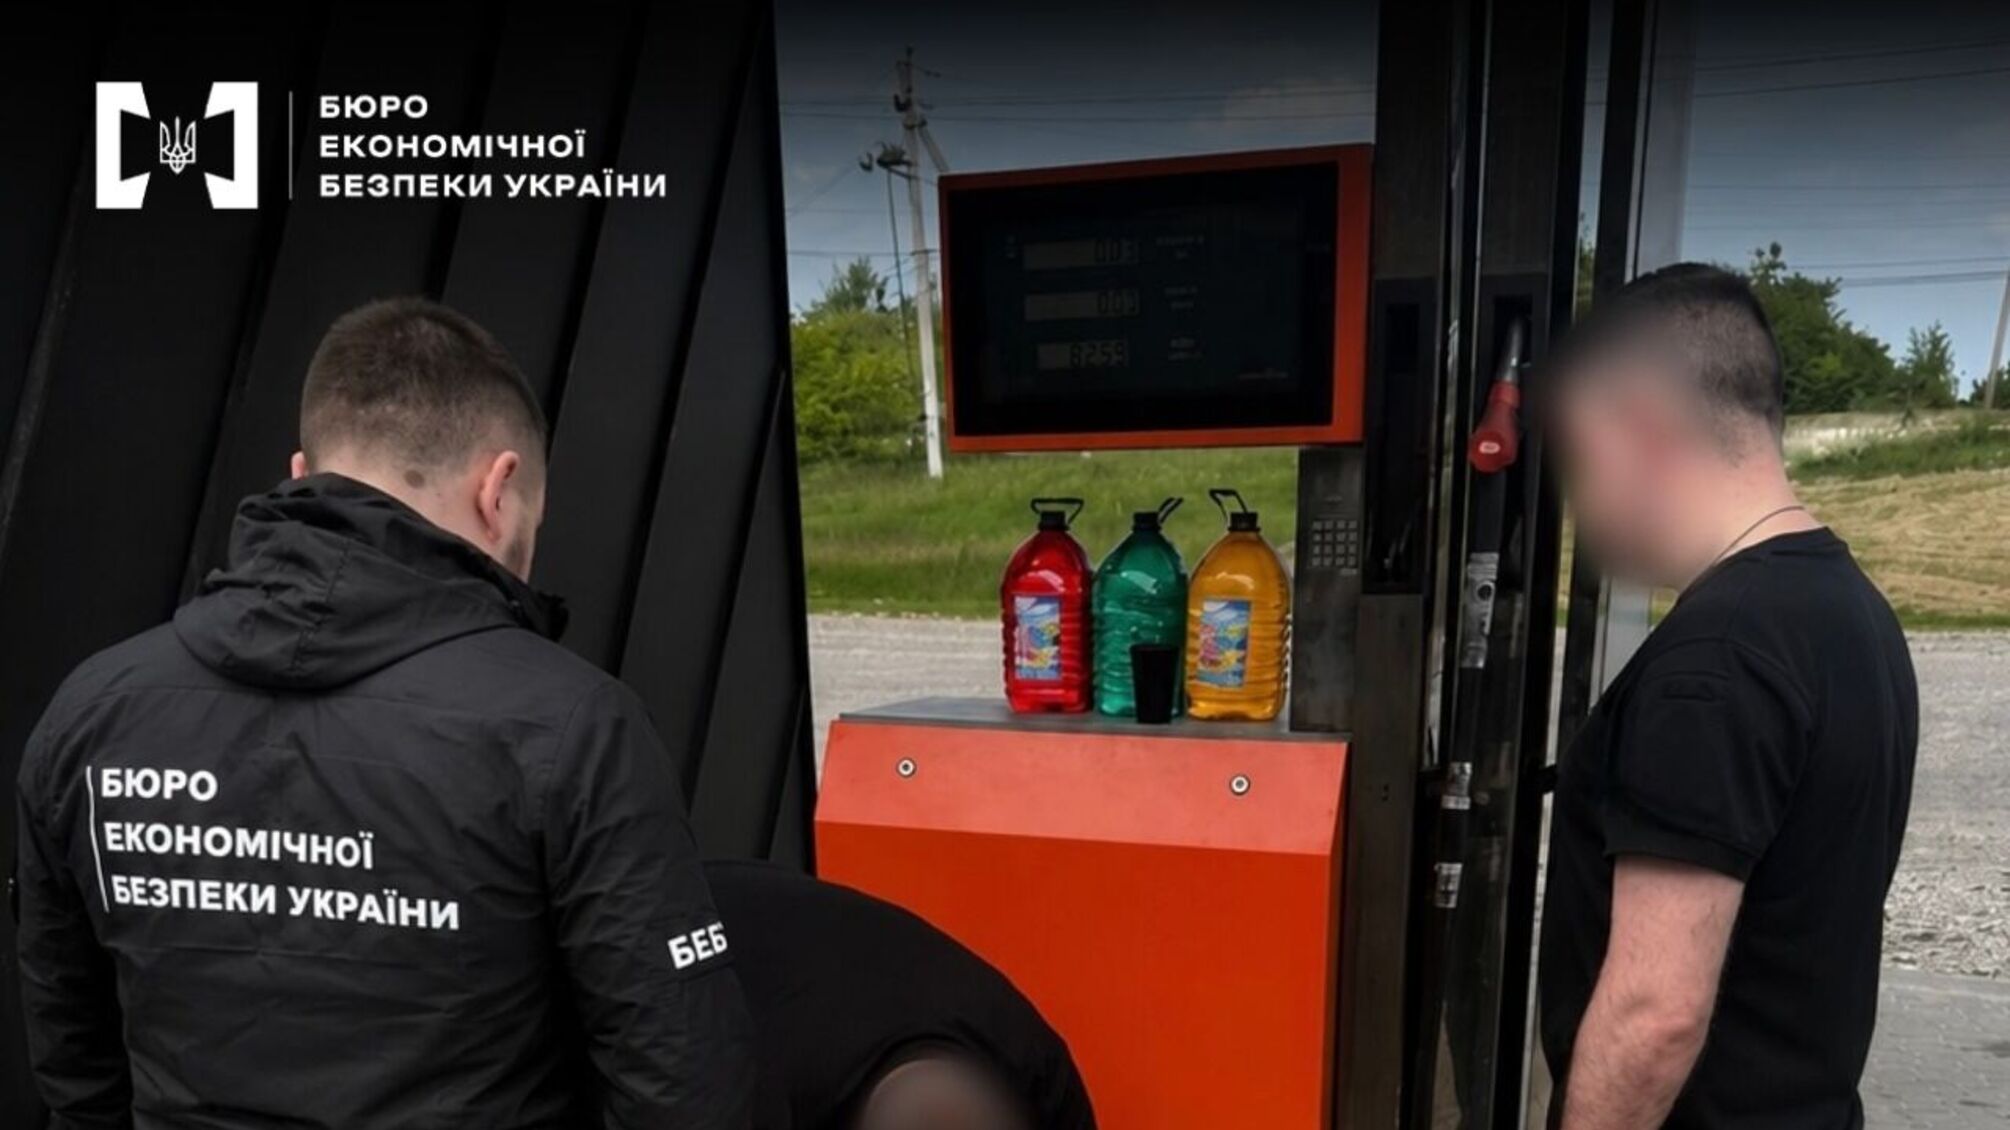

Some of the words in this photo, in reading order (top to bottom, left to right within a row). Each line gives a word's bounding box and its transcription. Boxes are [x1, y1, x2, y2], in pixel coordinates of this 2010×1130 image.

[101, 767, 218, 802] БЮРО
[103, 821, 374, 870] ЕКОНОМІЧНОЇ
[111, 874, 276, 915] БЕЗПЕКИ
[287, 886, 459, 930] УКРАЇНИ
[667, 921, 728, 969] БЕБ
